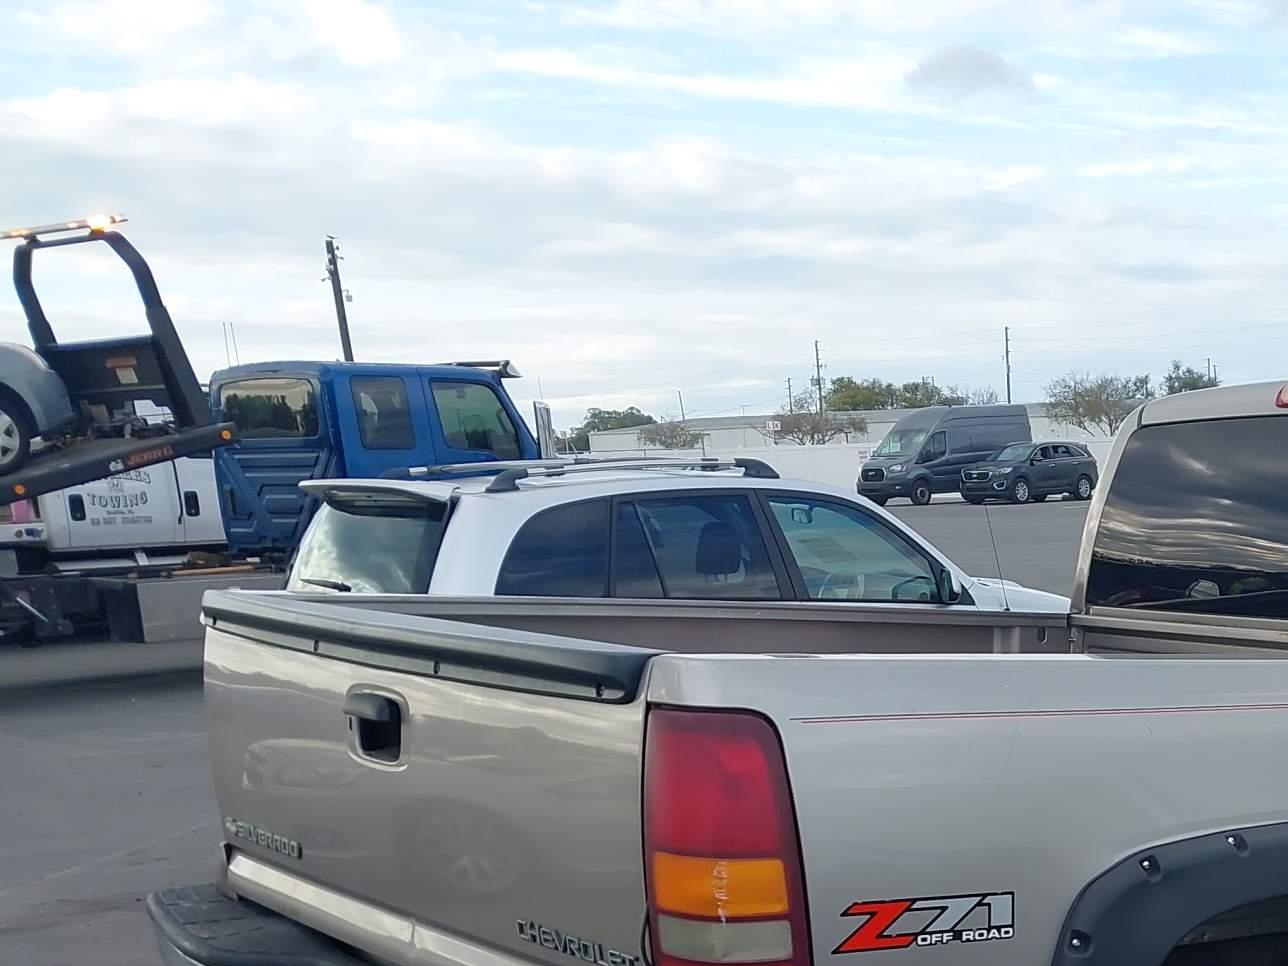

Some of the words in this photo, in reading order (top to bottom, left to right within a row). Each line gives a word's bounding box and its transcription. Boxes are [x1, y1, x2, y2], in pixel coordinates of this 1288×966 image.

[87, 491, 148, 509] TOWING
[234, 821, 301, 858] SILVERADO
[831, 891, 1015, 954] Z71
[916, 931, 954, 947] OFF
[962, 926, 1014, 943] ROAD
